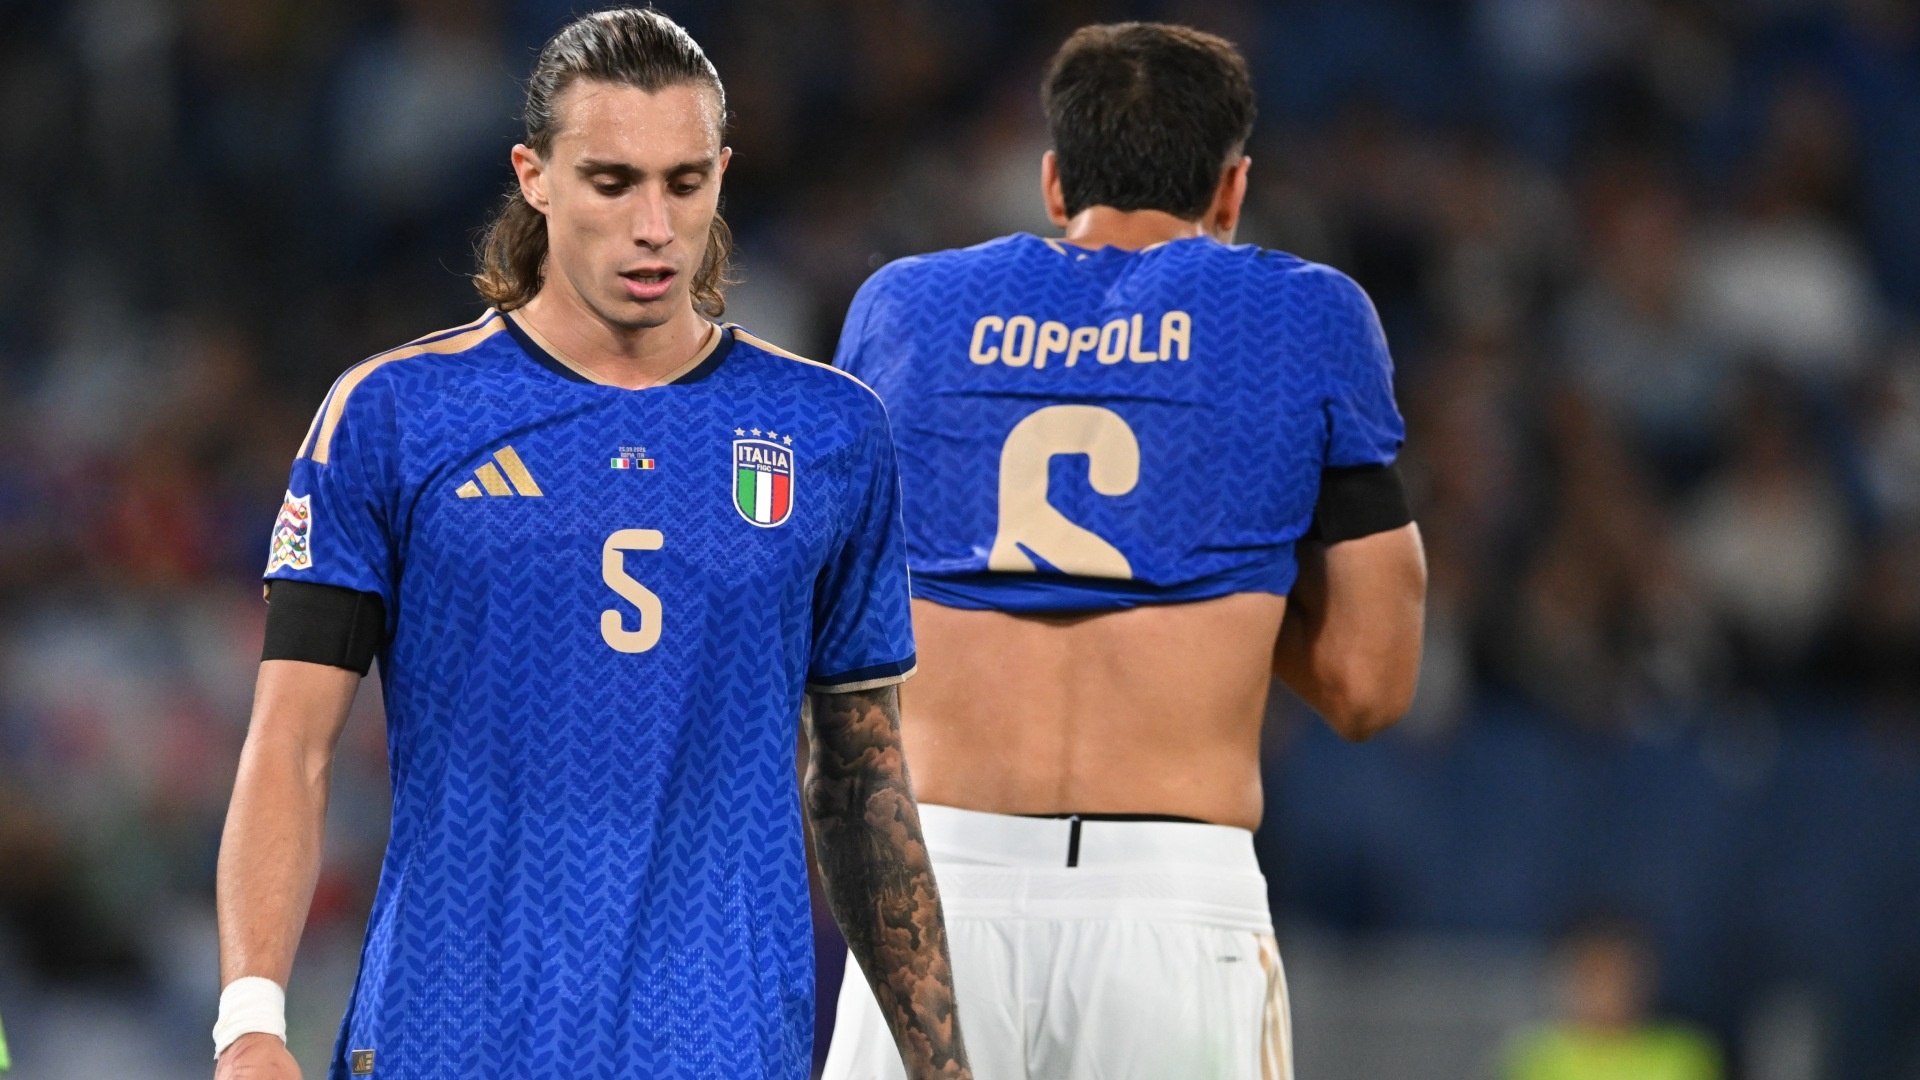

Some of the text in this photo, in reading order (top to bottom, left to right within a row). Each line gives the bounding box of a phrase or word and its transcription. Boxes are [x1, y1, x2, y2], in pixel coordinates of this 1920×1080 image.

[969, 311, 1191, 369] COPPOLA
[738, 446, 788, 468] ITALIA
[756, 464, 772, 473] FIGC
[601, 528, 664, 653] 5
